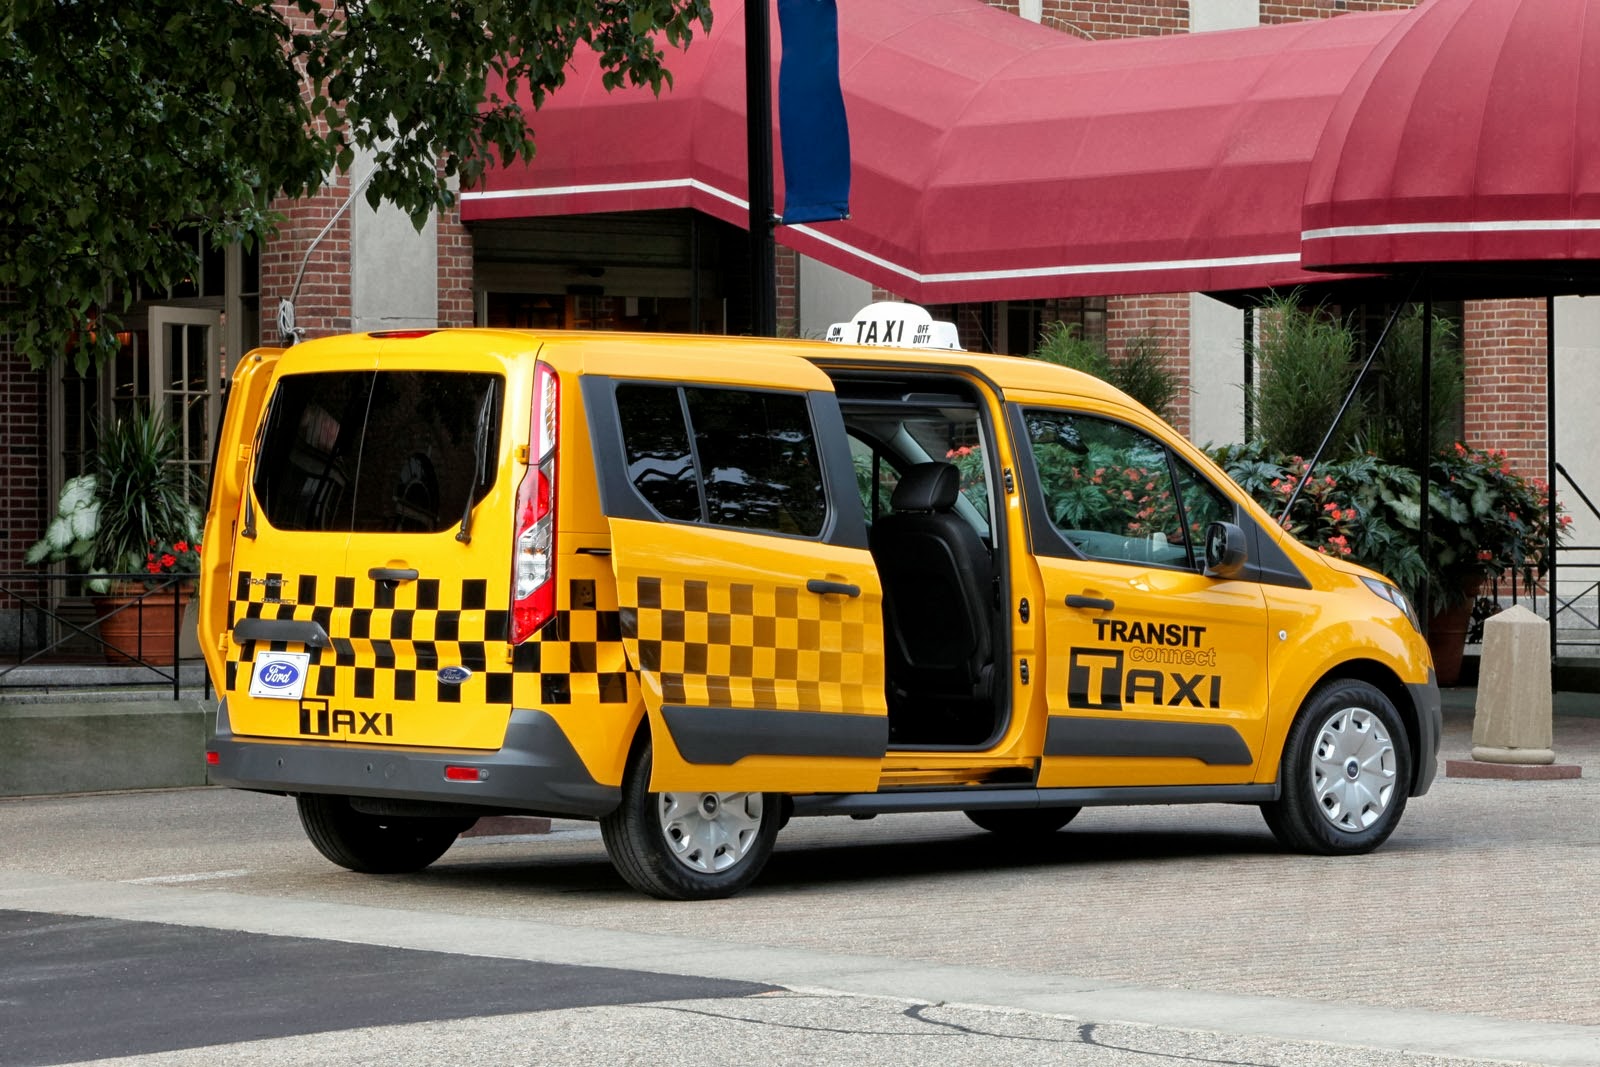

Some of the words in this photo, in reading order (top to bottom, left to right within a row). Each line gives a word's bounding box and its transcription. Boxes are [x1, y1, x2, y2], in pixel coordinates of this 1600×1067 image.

[832, 327, 841, 336] ON
[856, 320, 904, 343] TAXI
[913, 334, 931, 344] DUTY
[917, 324, 930, 334] OFF
[1092, 618, 1206, 647] TRANSIT
[1129, 647, 1216, 667] connect
[264, 664, 292, 684] Ford
[443, 668, 462, 680] Ford
[1068, 646, 1221, 711] TAXI
[299, 699, 393, 736] TAXI
